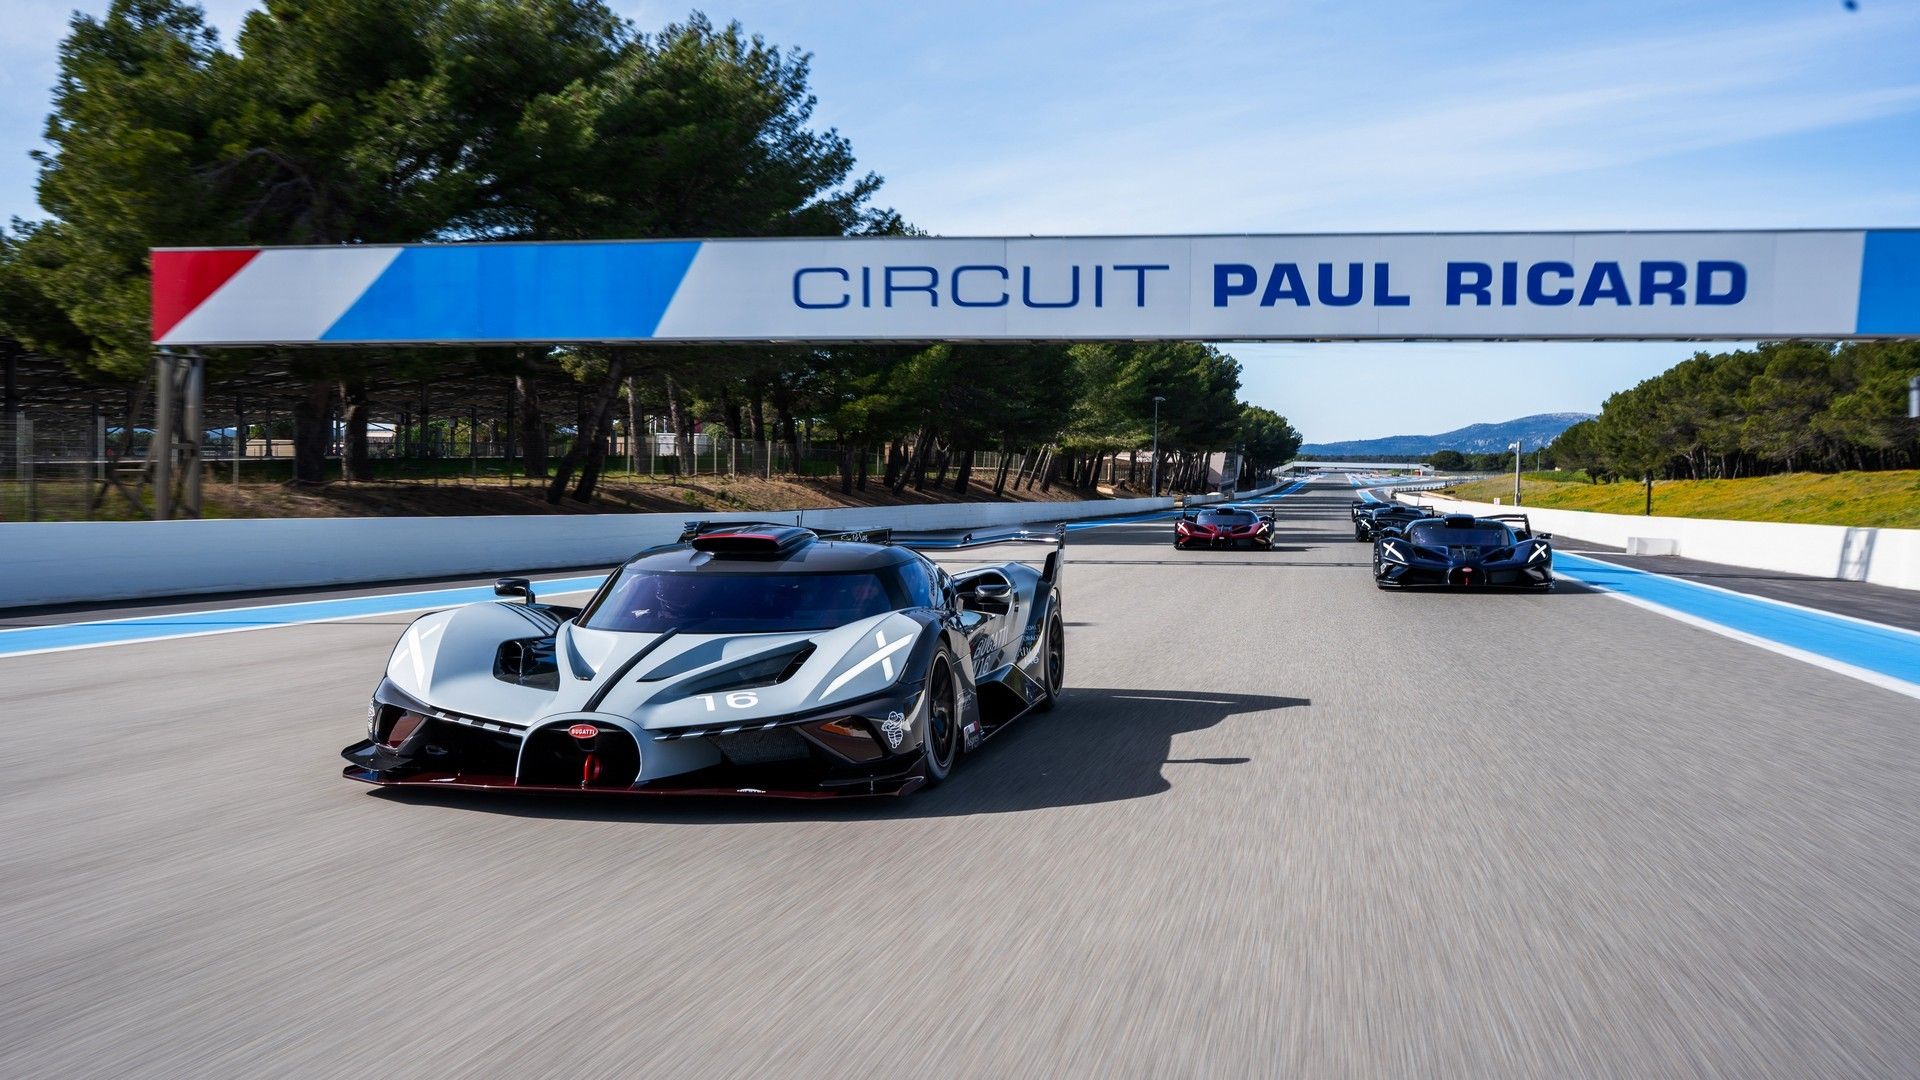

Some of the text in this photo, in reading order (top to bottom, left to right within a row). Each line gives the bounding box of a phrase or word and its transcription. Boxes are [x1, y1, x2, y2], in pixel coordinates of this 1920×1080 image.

[793, 260, 1748, 310] CIRCUIT PAUL RICARD
[695, 691, 759, 712] 16
